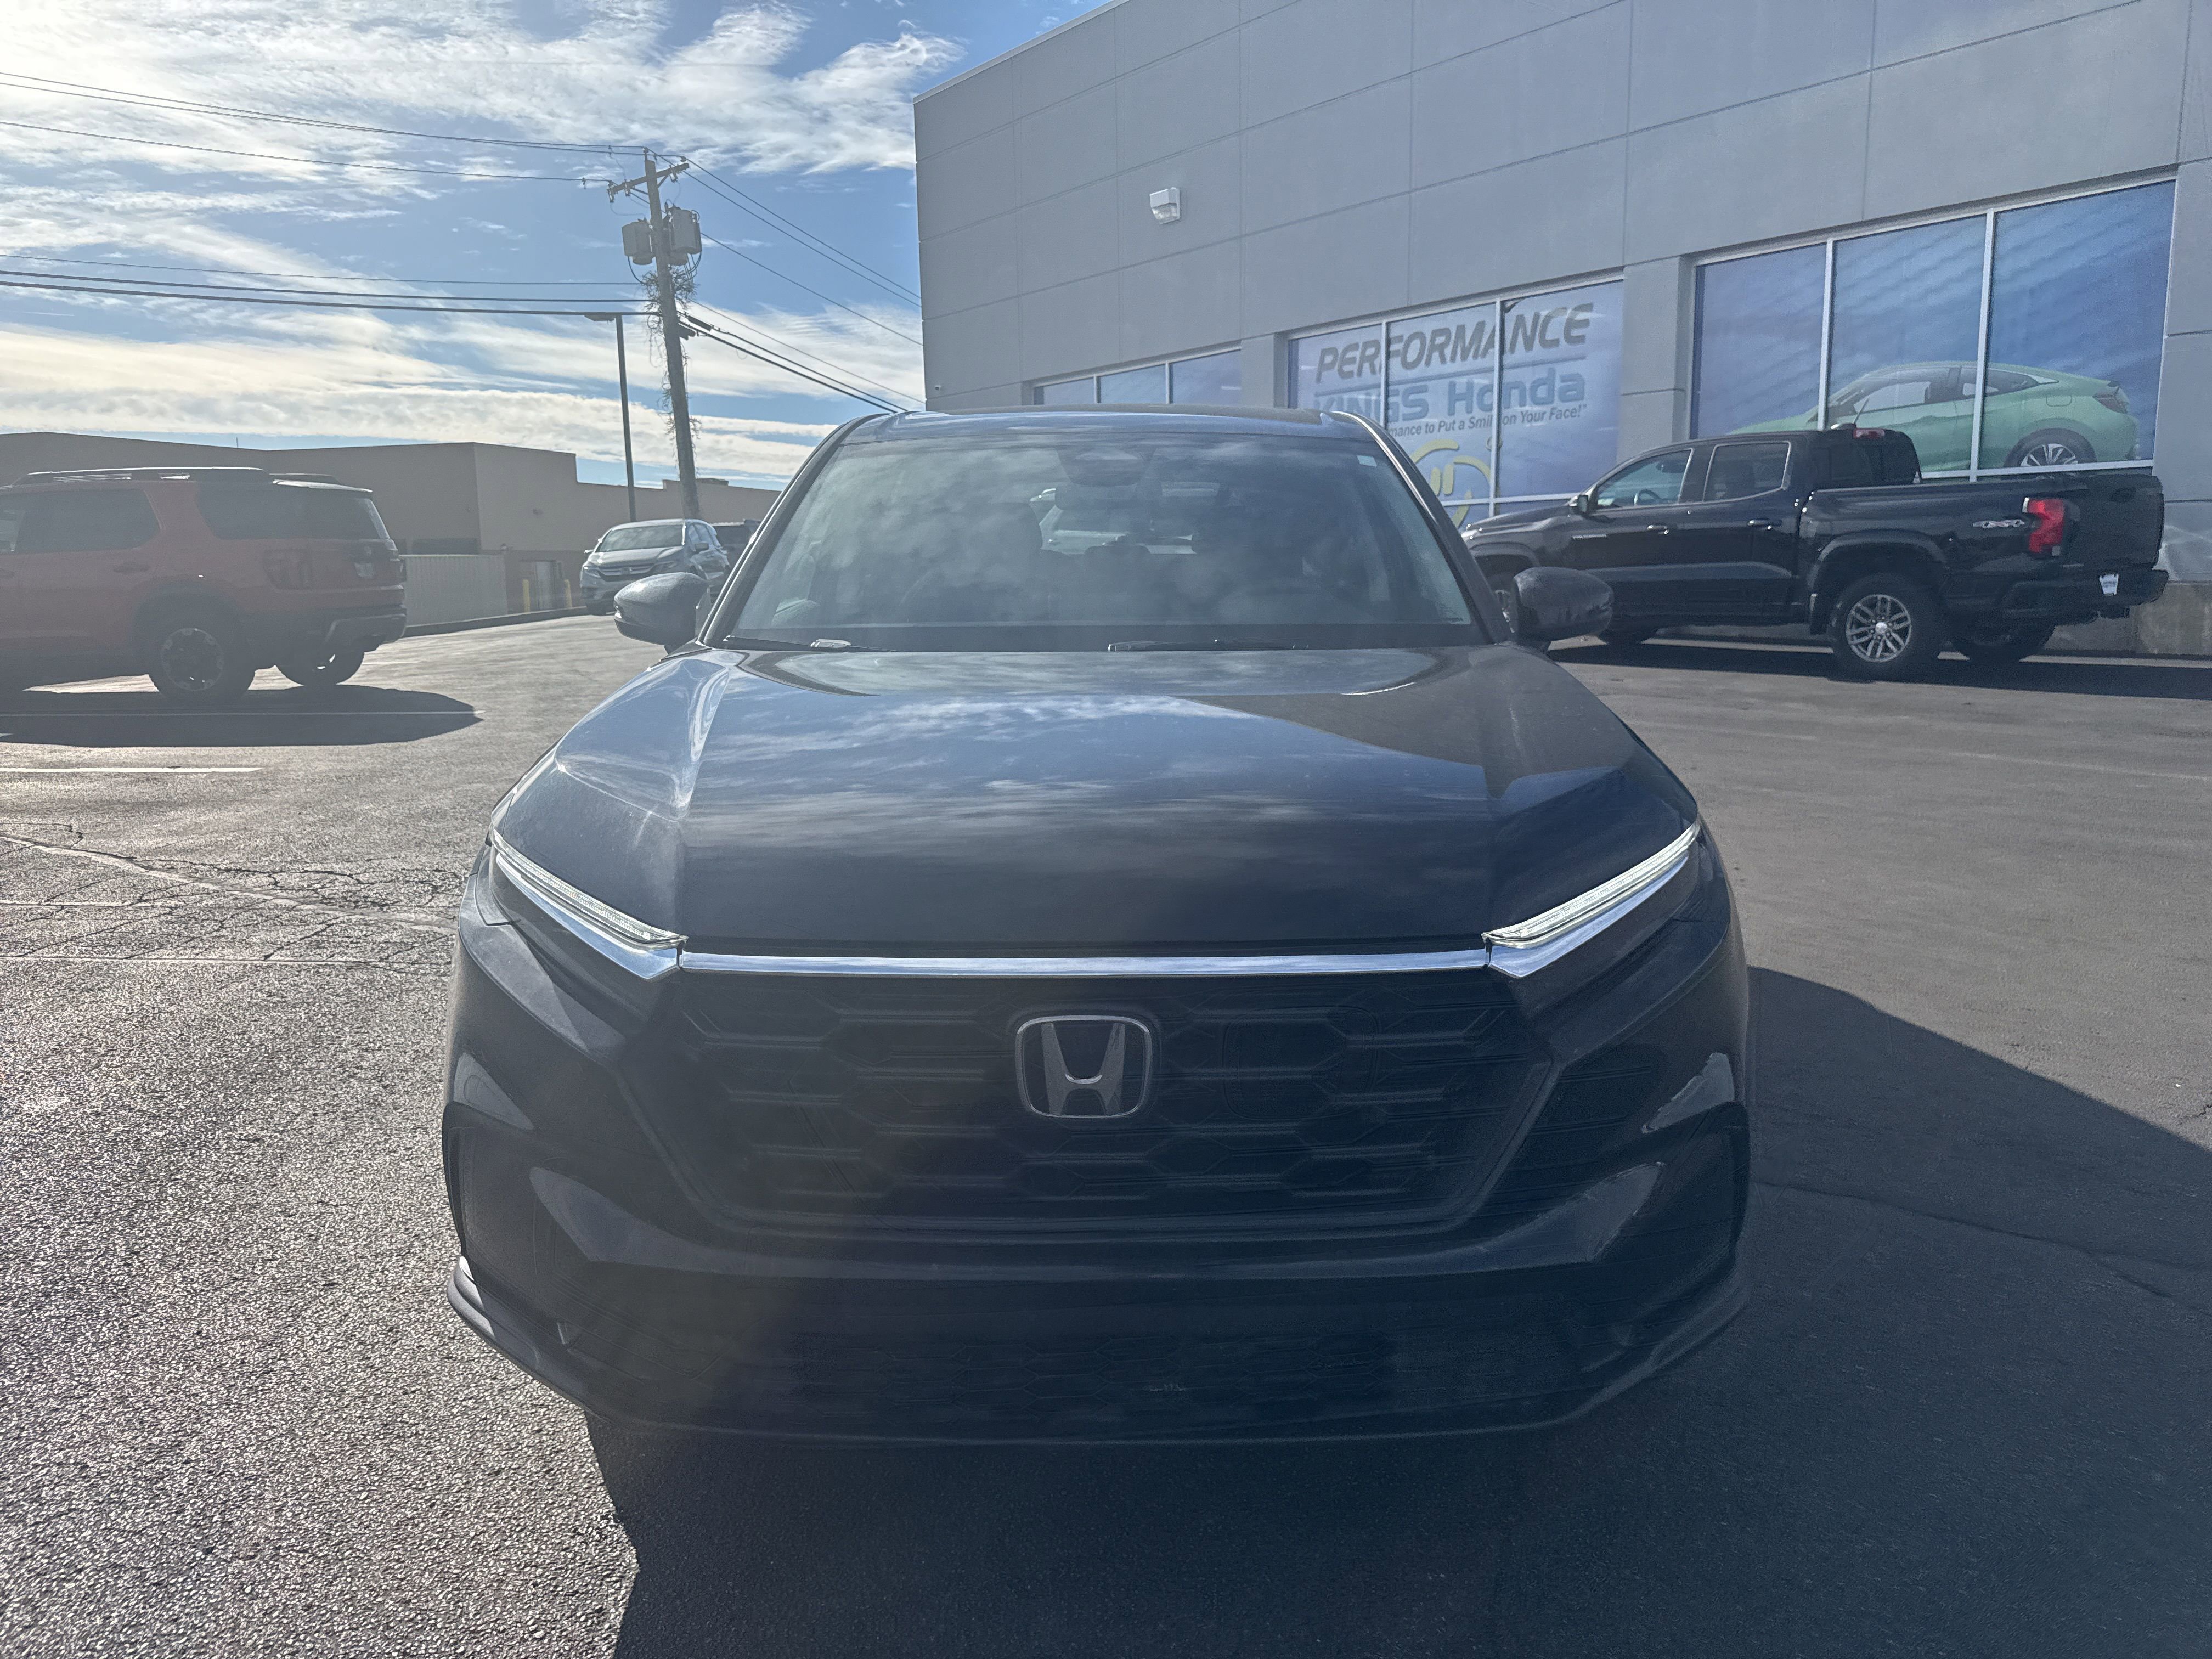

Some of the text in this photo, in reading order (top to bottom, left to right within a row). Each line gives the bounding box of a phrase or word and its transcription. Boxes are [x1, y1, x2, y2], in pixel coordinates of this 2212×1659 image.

[1315, 303, 1594, 383] PERFORMANCE
[1448, 368, 1586, 417] Honda
[1425, 422, 1435, 434] to
[1438, 419, 1456, 433] Put
[1458, 420, 1465, 431] a
[1468, 414, 1493, 430] Smil
[1502, 414, 1516, 425] on
[1520, 409, 1547, 424] Your
